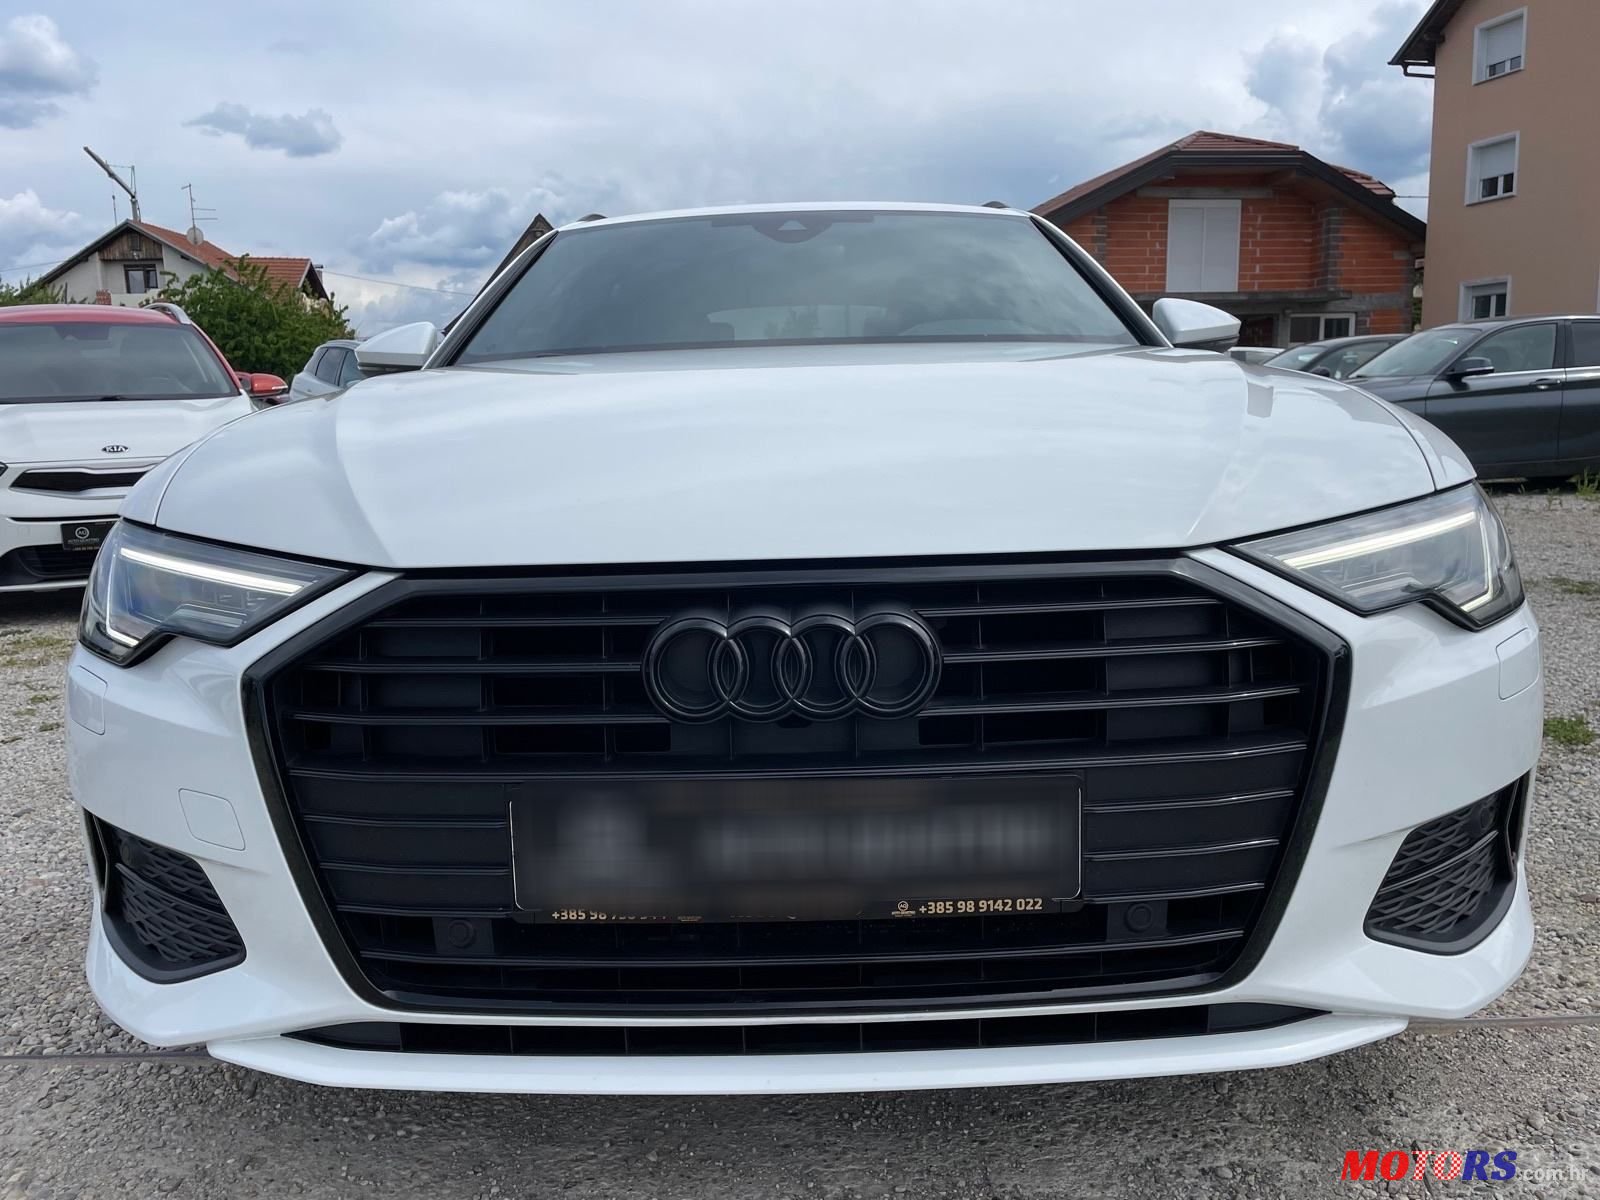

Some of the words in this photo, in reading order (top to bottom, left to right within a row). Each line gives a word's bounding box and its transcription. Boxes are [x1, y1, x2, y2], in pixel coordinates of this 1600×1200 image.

[103, 445, 129, 453] KIA
[919, 901, 954, 914] +385
[957, 901, 975, 913] 98
[978, 899, 1012, 912] 9142
[1016, 898, 1043, 910] 022
[552, 909, 586, 920] +385
